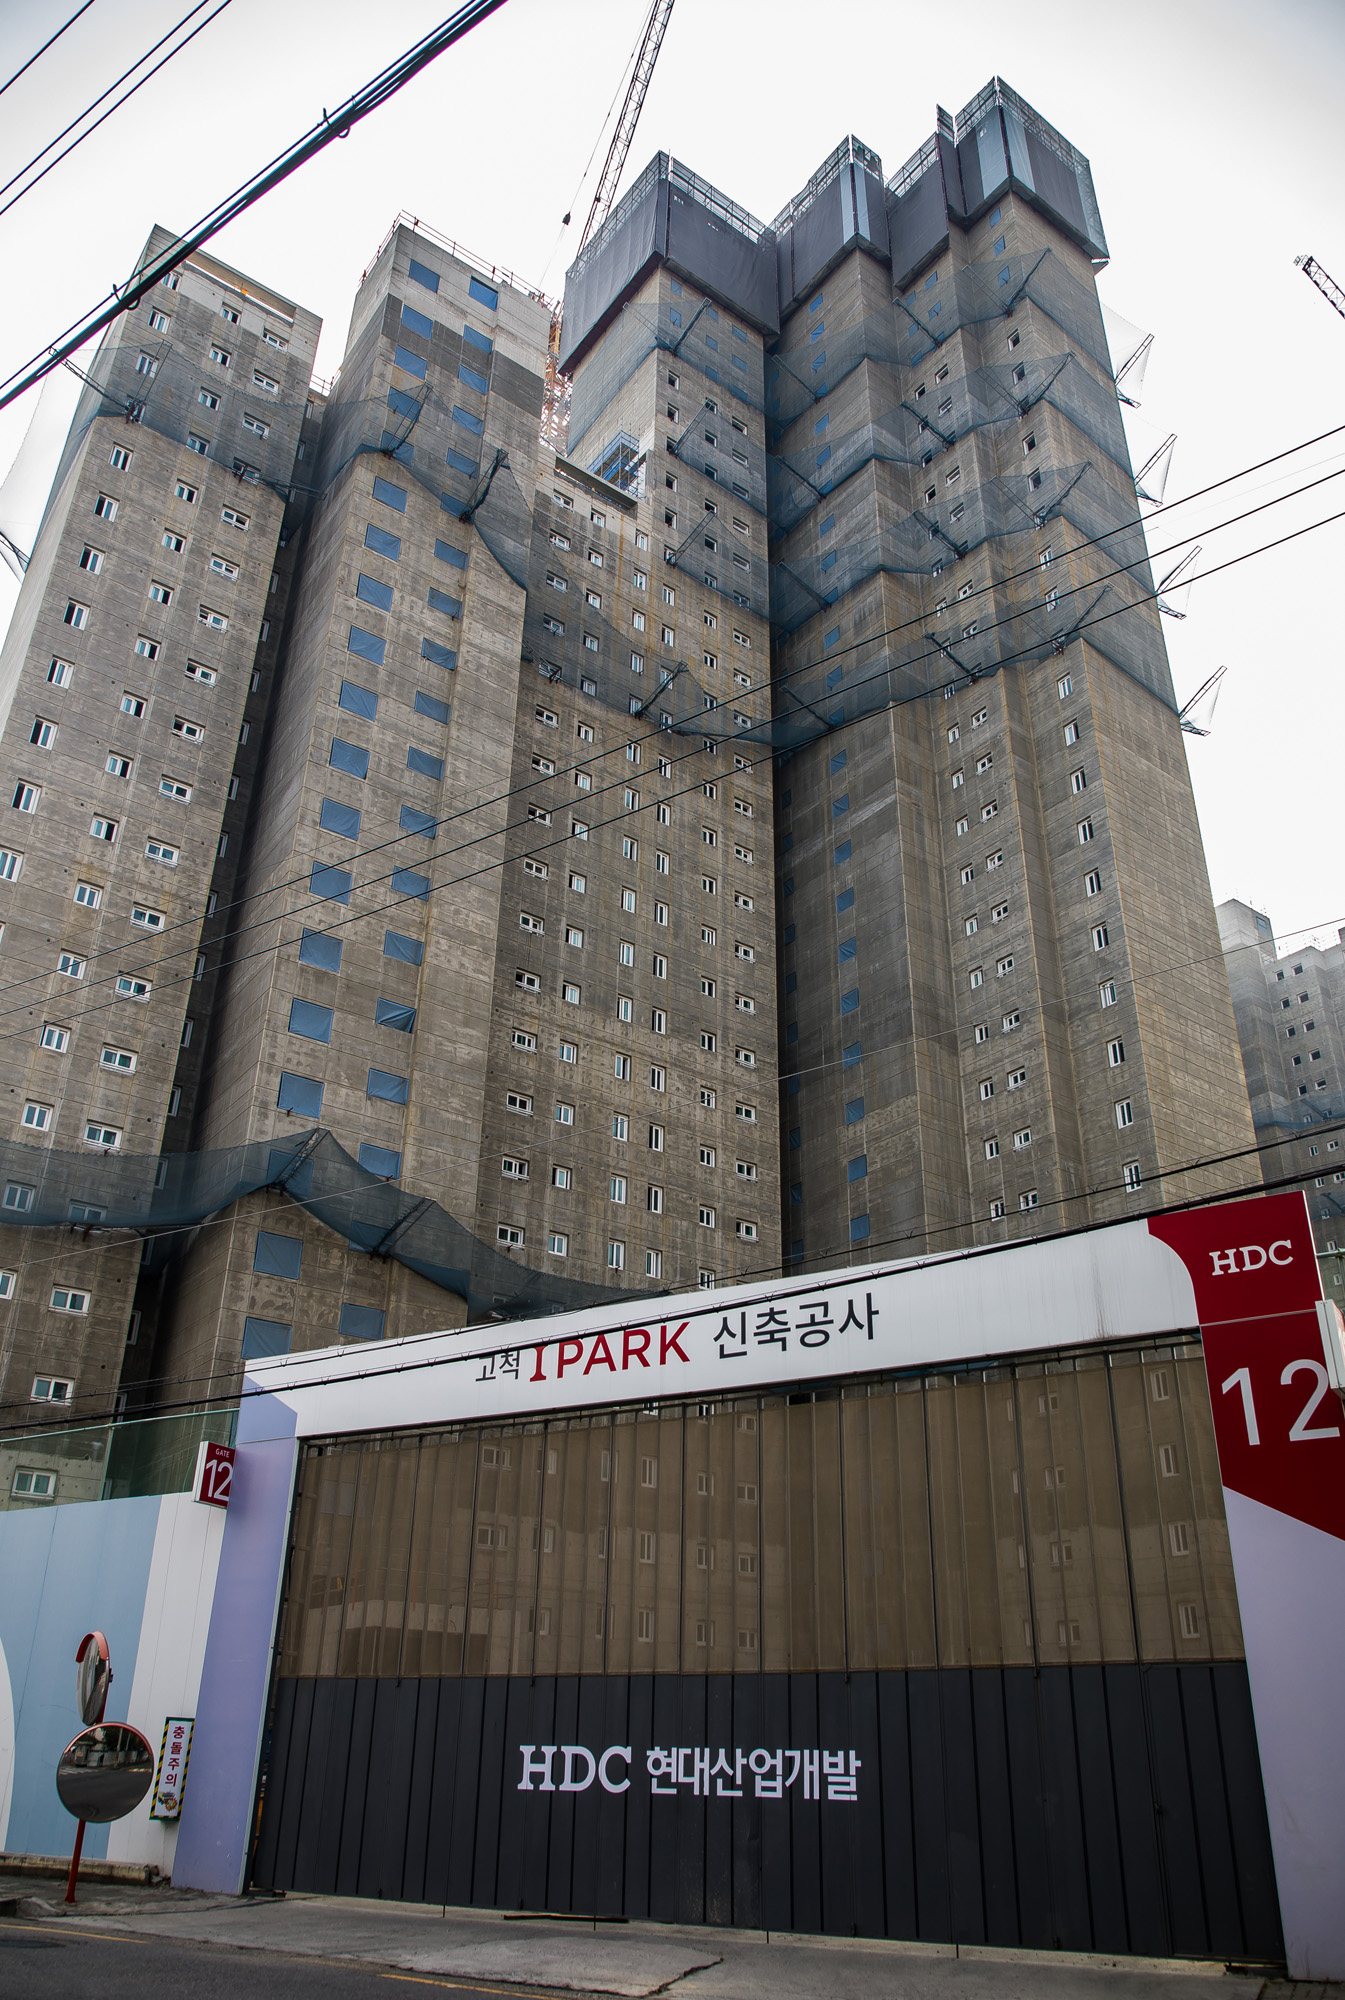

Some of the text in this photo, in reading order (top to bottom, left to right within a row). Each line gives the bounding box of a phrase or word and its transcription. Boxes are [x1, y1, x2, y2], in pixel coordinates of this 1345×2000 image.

[1209, 1239, 1294, 1276] HDC
[475, 1292, 880, 1382] 고척 IPARK 신축공사
[1221, 1358, 1341, 1446] 12
[206, 1459, 233, 1501] 12
[215, 1448, 230, 1458] GATE
[165, 1725, 185, 1787] 충돌주의
[517, 1745, 862, 1801] HDC 현대산업개발
